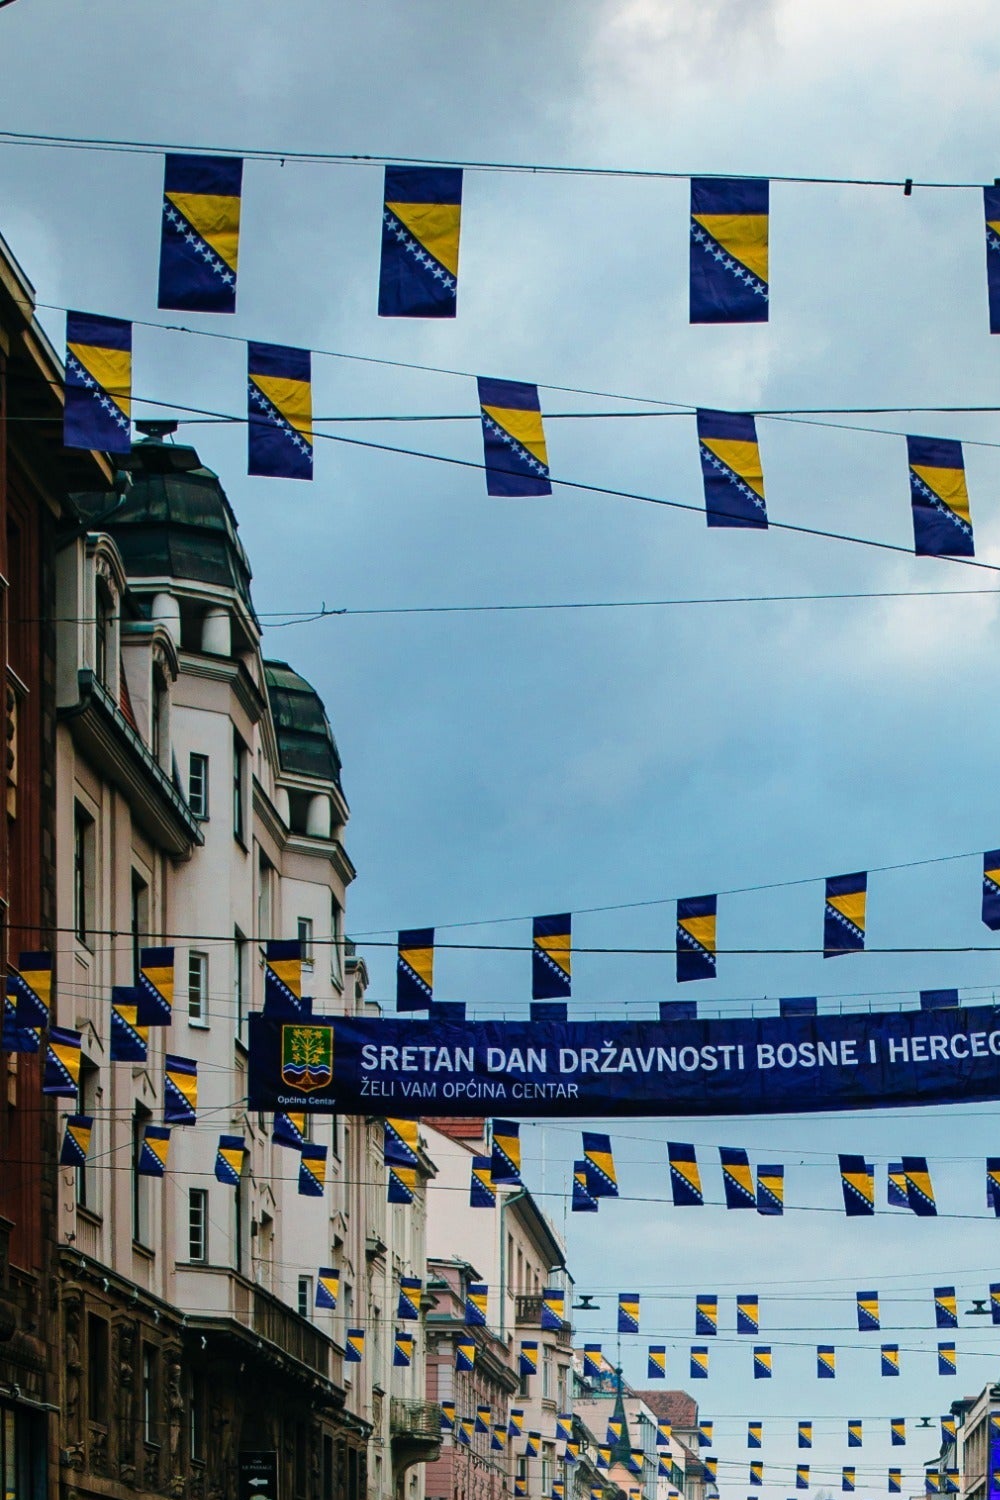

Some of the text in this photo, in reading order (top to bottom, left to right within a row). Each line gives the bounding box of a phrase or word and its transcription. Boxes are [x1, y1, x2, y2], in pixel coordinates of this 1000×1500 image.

[360, 1044, 475, 1073] SRETAN
[486, 1047, 547, 1073] DAN
[559, 1040, 745, 1074] DRŽAVNOSTI
[757, 1039, 858, 1070] BOSNE
[869, 1040, 878, 1064] I
[360, 1076, 579, 1100] ŽELI VAM OPĆINA CENTAR
[277, 1095, 336, 1106] Općina Centar
